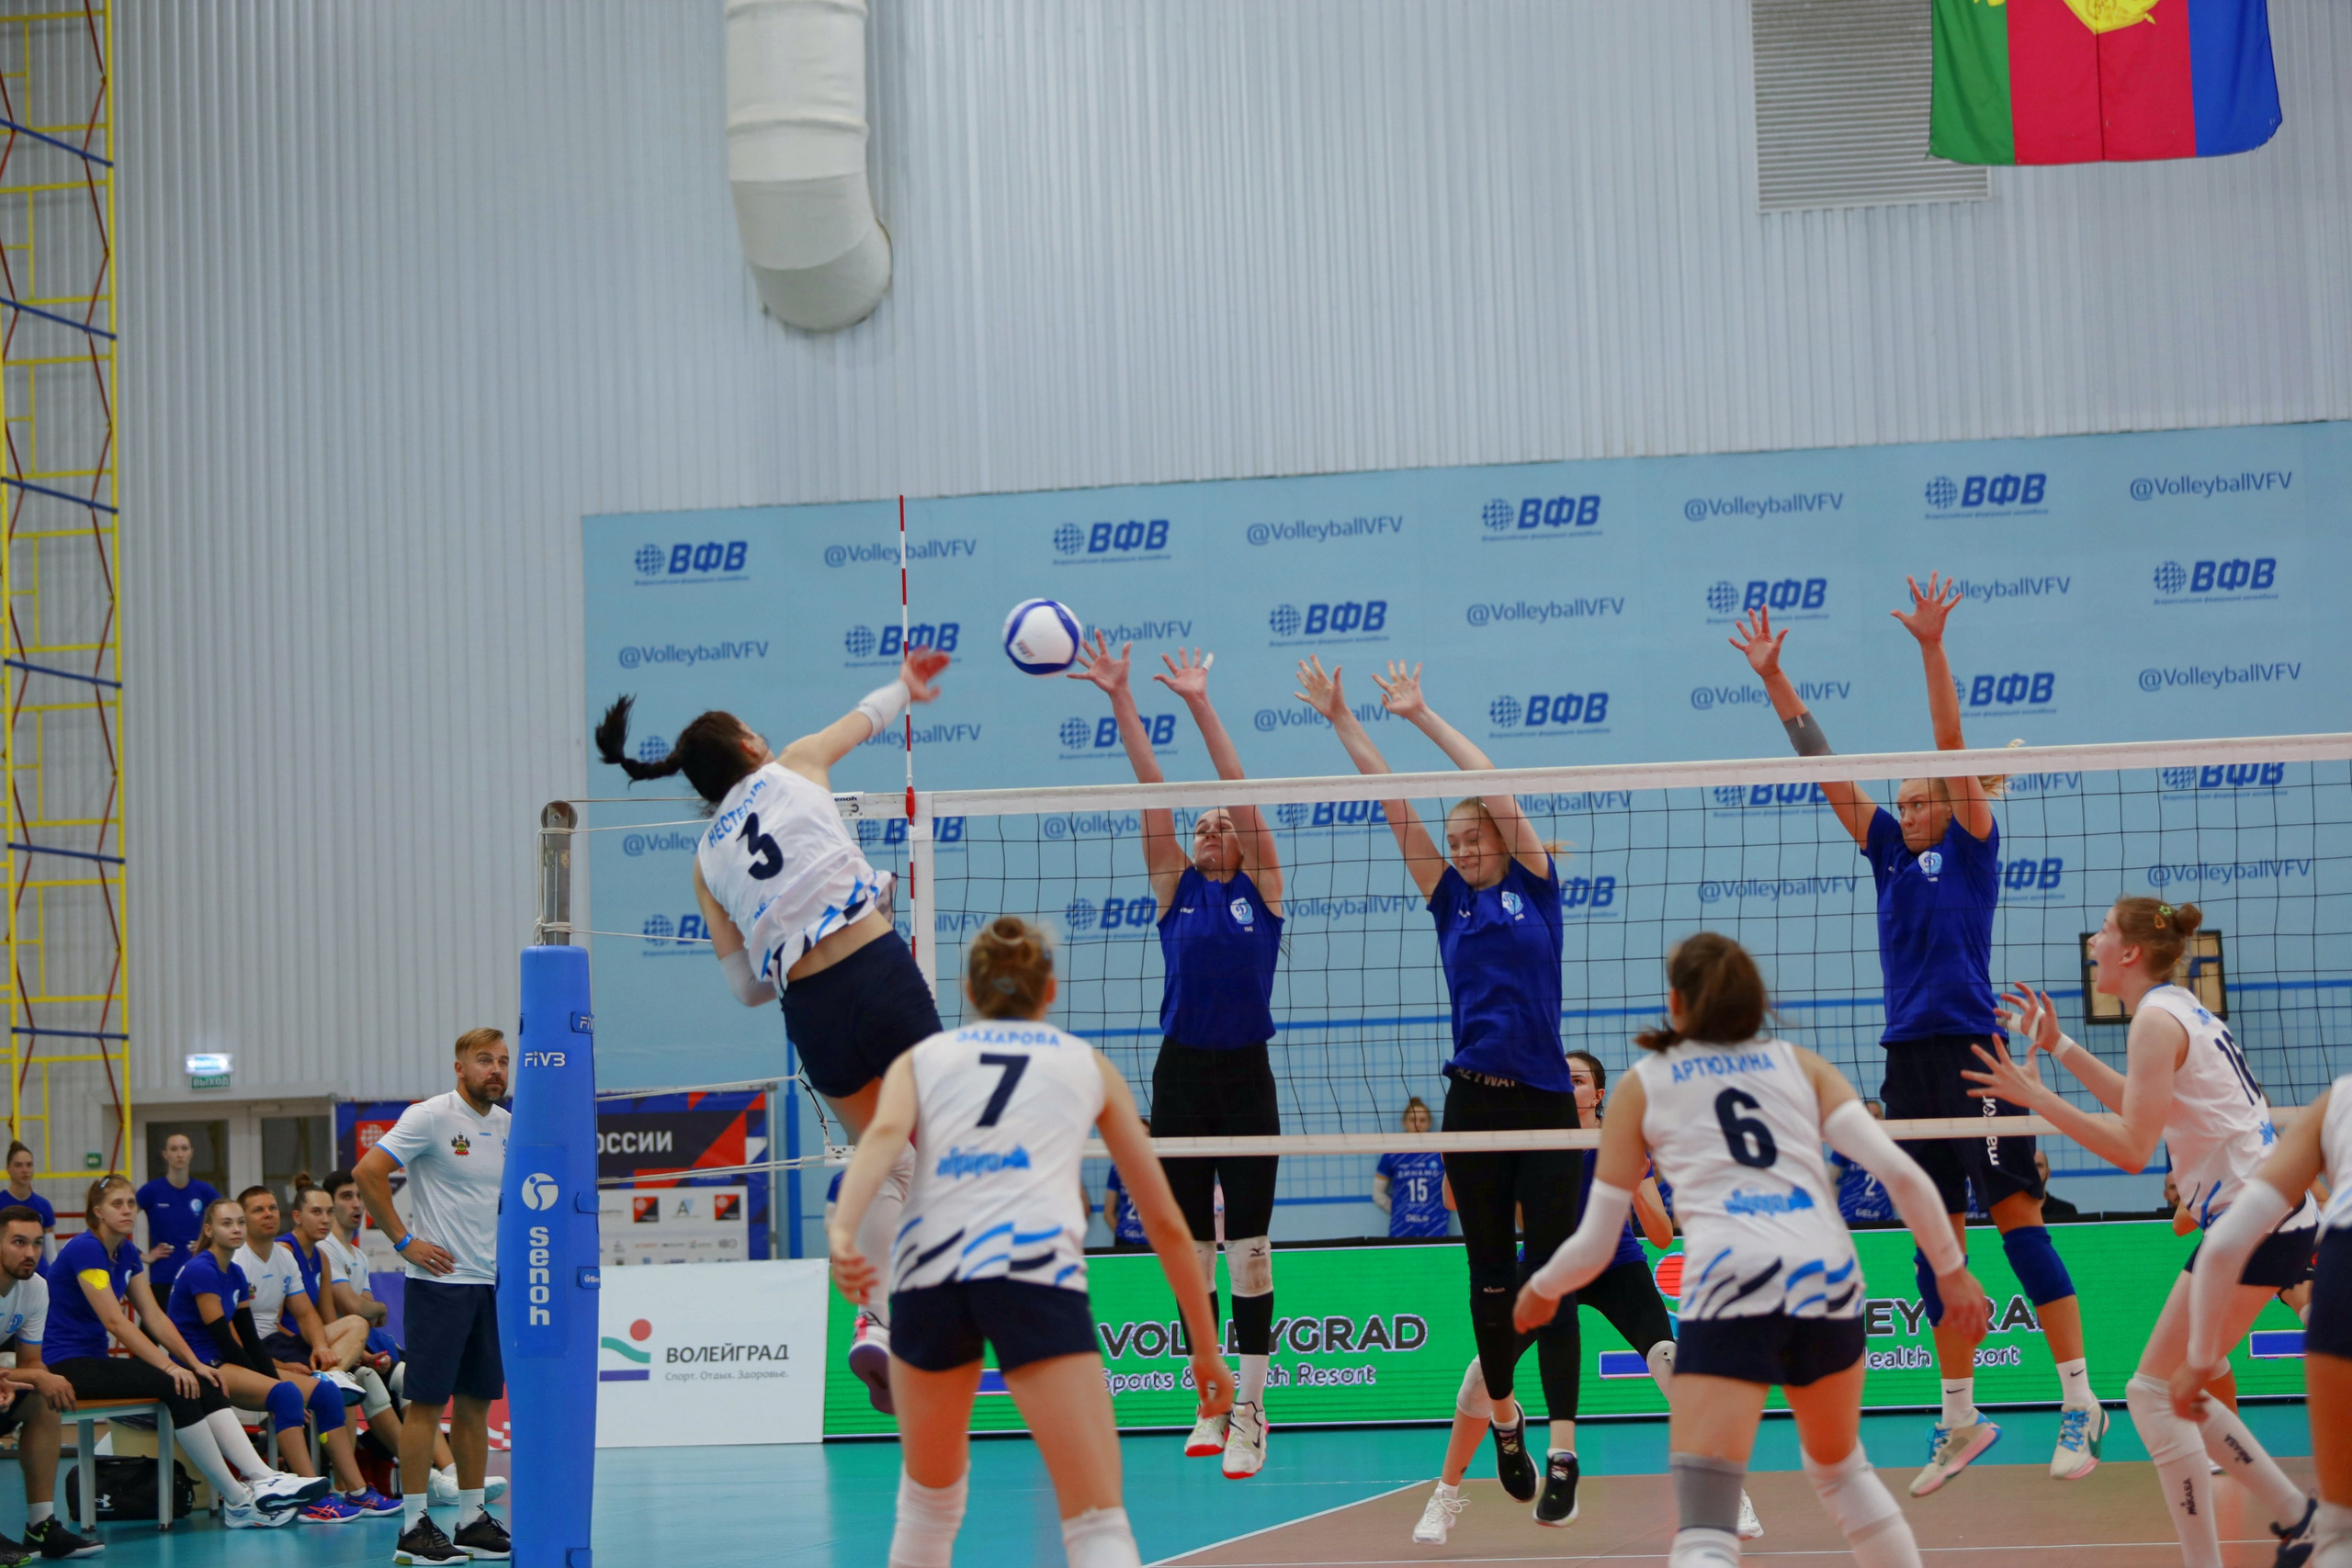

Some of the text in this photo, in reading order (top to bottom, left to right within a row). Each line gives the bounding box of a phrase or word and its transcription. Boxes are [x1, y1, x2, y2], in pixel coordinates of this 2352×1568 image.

[1961, 473, 2047, 507] ВФВ
[2130, 471, 2292, 501] @VolleyballVFV
[1518, 494, 1601, 529] ВФВ
[1684, 492, 1844, 522] @VolleyballVFV
[1088, 519, 1170, 553] ВФВ
[1247, 515, 1403, 546] @VolleyballVFV
[668, 540, 748, 574] ВФВ
[824, 538, 977, 568] @VolleyballVFV
[2190, 558, 2277, 592] ВФВ
[1466, 597, 1624, 626] @VolleyballVFV
[1743, 578, 1826, 612] ВФВ
[1305, 600, 1387, 635] ВФВ
[618, 640, 769, 669] @VolleyballVFV
[1970, 672, 2055, 706] ВФВ
[2139, 662, 2301, 692] @VolleyballVFV
[1525, 692, 1609, 727] ВФВ
[1094, 714, 1176, 748] ВВ
[736, 812, 784, 880] 3
[1698, 875, 1857, 903] @VolleyballVFV
[2147, 859, 2311, 888] @VolleyballVFV
[1282, 894, 1418, 919] VolleyballVFV
[1562, 875, 1616, 908] ФВ
[1101, 896, 1158, 930] ВФ
[1672, 1053, 1776, 1084] АРТЮХИНА
[976, 1053, 1030, 1128] 7
[1714, 1088, 1778, 1169] 6
[1407, 1178, 1429, 1202] 15
[1864, 1173, 1876, 1196] 2
[529, 1226, 550, 1325] Senoh
[666, 1343, 789, 1364] ВОЛЕЙГРАД
[1864, 1344, 2021, 1370] ealth sort
[665, 1369, 789, 1382] Спорт. Отдых. Здоровье.
[1102, 1368, 1175, 1396] Sports
[1296, 1361, 1377, 1386] Resort
